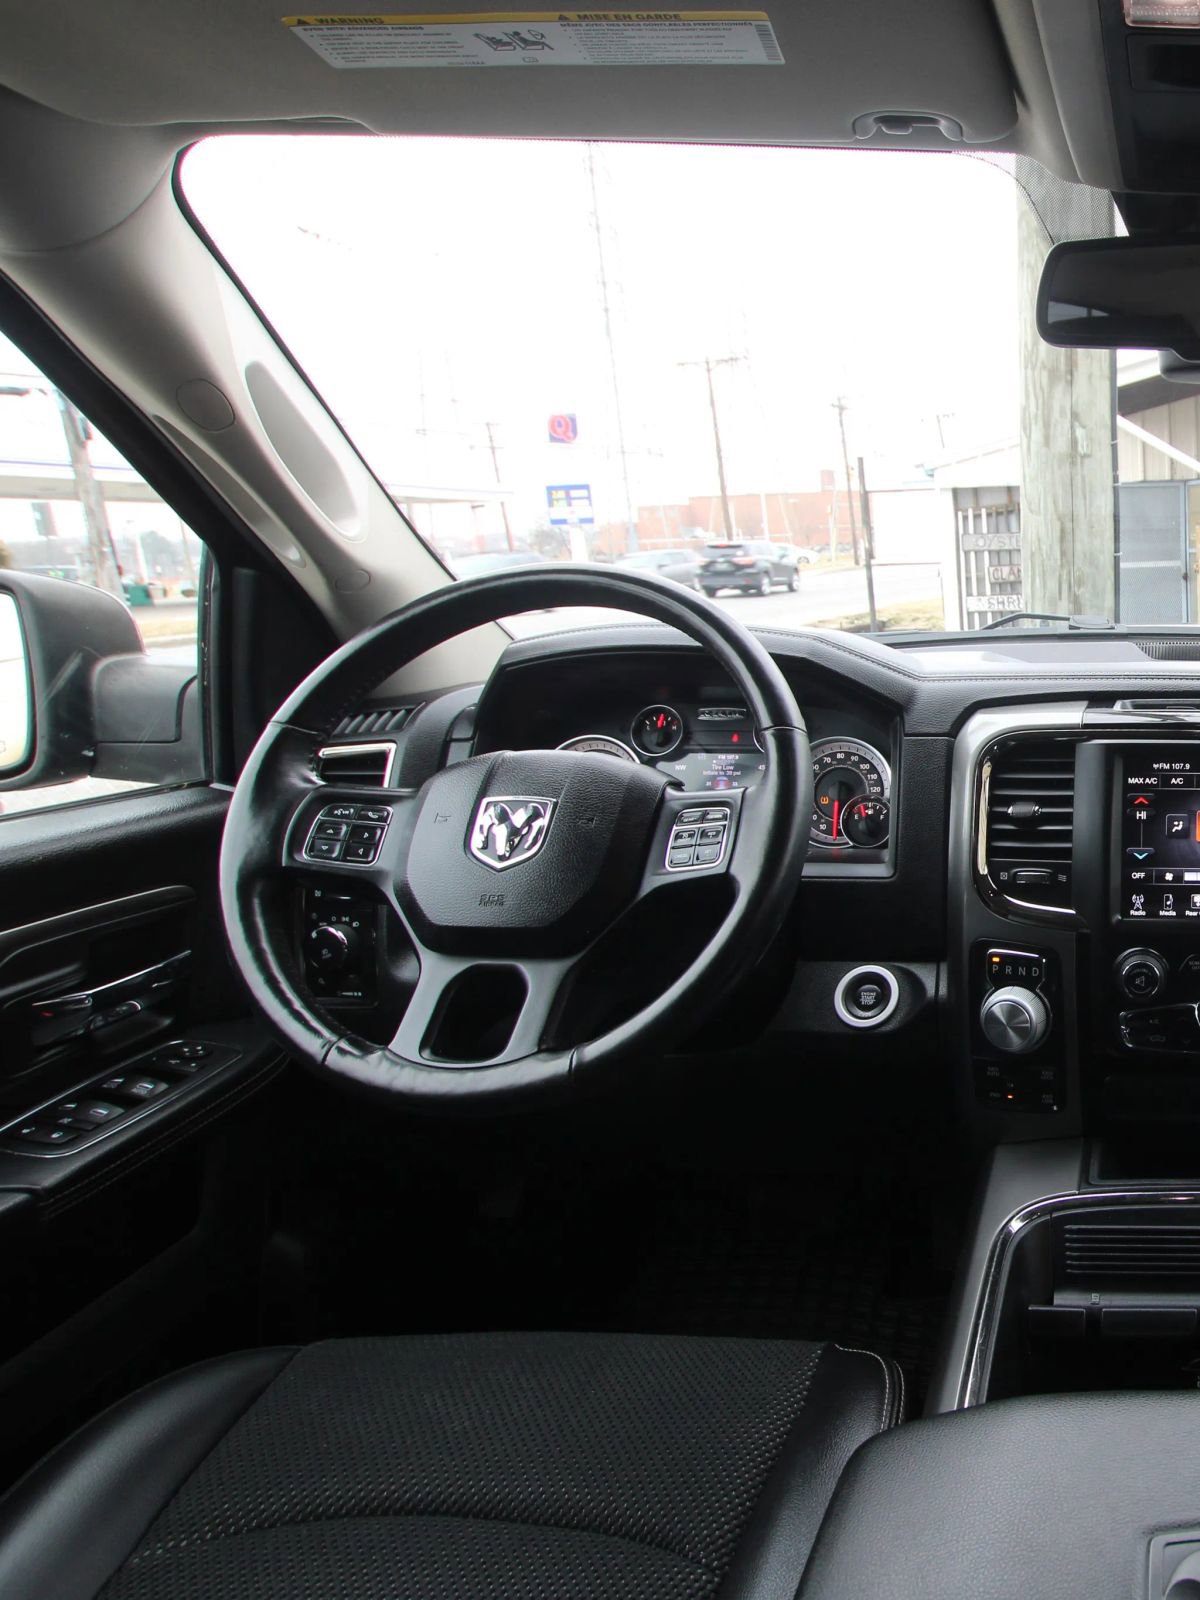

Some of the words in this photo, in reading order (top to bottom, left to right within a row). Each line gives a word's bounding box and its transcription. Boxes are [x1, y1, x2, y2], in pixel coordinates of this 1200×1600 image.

[314, 16, 384, 25] WARNING
[1136, 811, 1146, 820] HI
[992, 965, 999, 974] P
[1006, 966, 1012, 975] R
[1019, 967, 1026, 976] N
[1032, 968, 1039, 977] D
